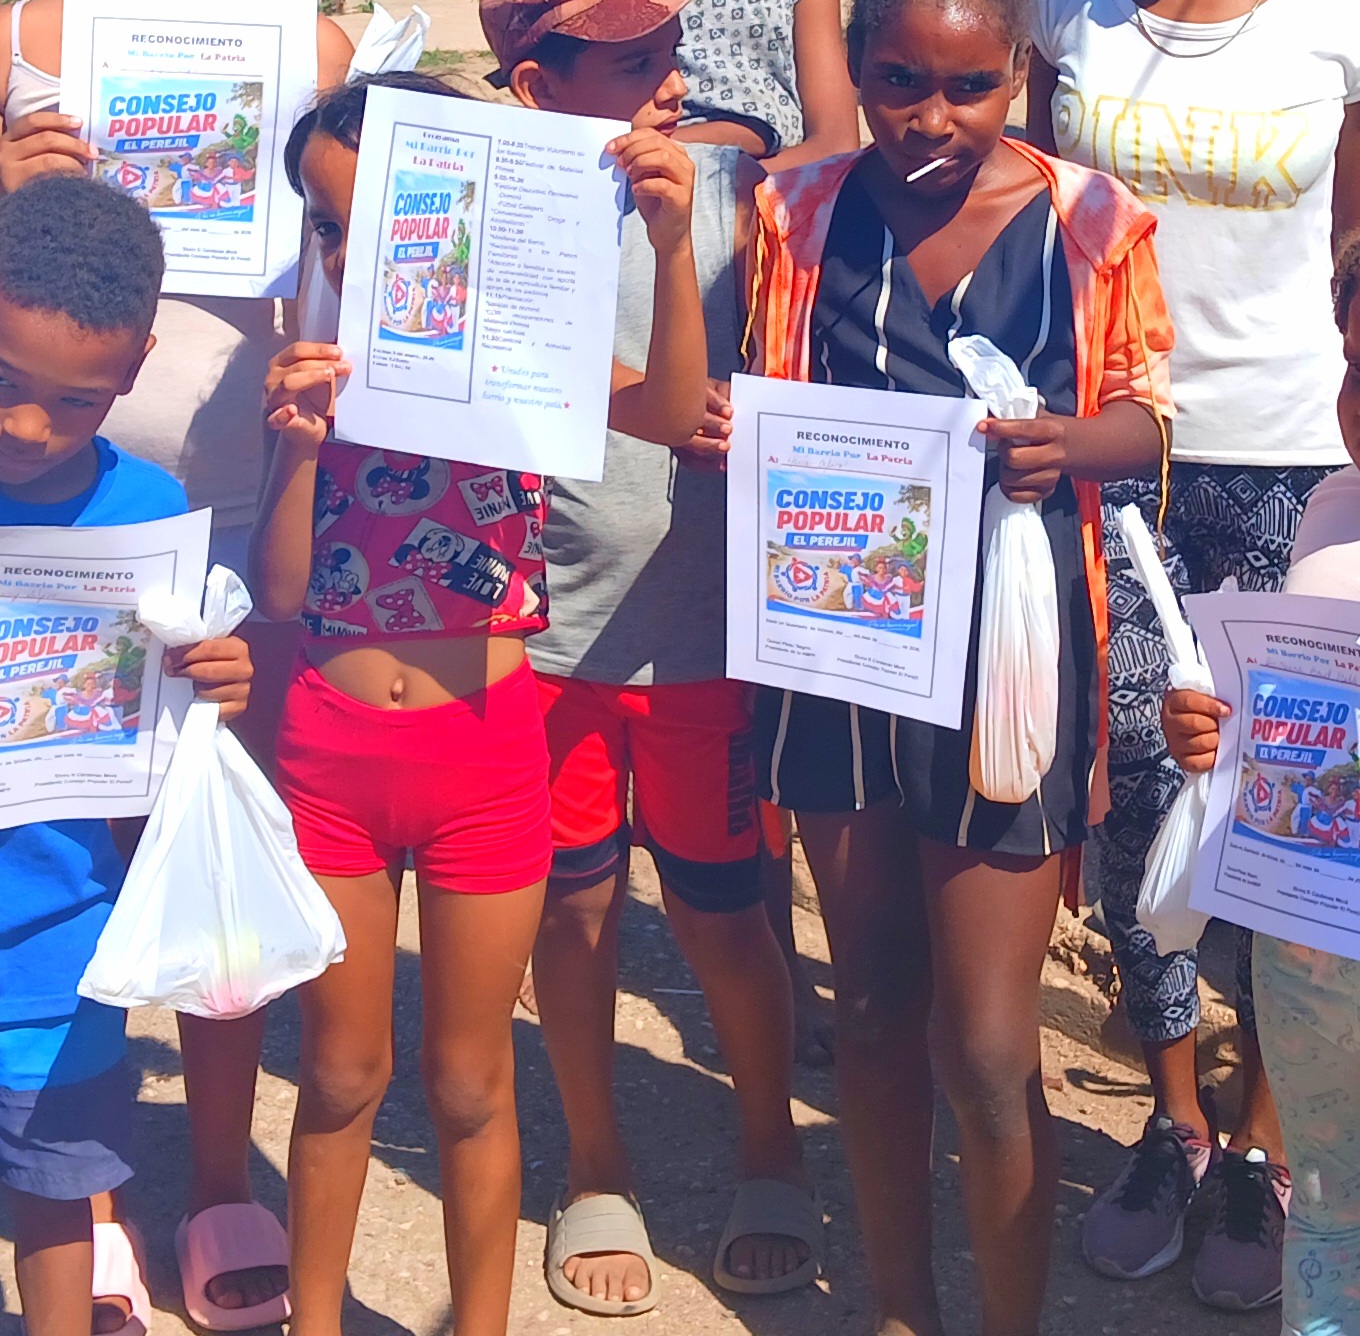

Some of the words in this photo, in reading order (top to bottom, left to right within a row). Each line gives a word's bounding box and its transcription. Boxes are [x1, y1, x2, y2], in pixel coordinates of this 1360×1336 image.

[131, 34, 243, 47] RECONOCIMIENTO
[108, 92, 217, 117] CONSEJO
[107, 113, 218, 138] POPULAR
[123, 139, 138, 151] EL
[140, 136, 189, 150] PEREJIL
[393, 191, 451, 217] CONSEJO
[390, 217, 450, 242] POPULAR
[796, 430, 910, 451] RECONOCIMIENTO
[807, 447, 841, 457] Barrio
[866, 452, 879, 461] La
[881, 454, 913, 466] Patria
[776, 489, 884, 512] CONSEJO
[776, 510, 885, 534] POPULAR
[792, 535, 807, 546] EL
[809, 535, 858, 547] PEREJIL
[4, 566, 134, 580] RECONOCIMIENTO
[83, 584, 96, 592] La
[100, 585, 136, 593] Patria
[9, 657, 64, 678] PEREJIL
[1334, 659, 1346, 669] La
[1252, 692, 1350, 725] CONSEJO
[1251, 718, 1346, 750] POPULAR
